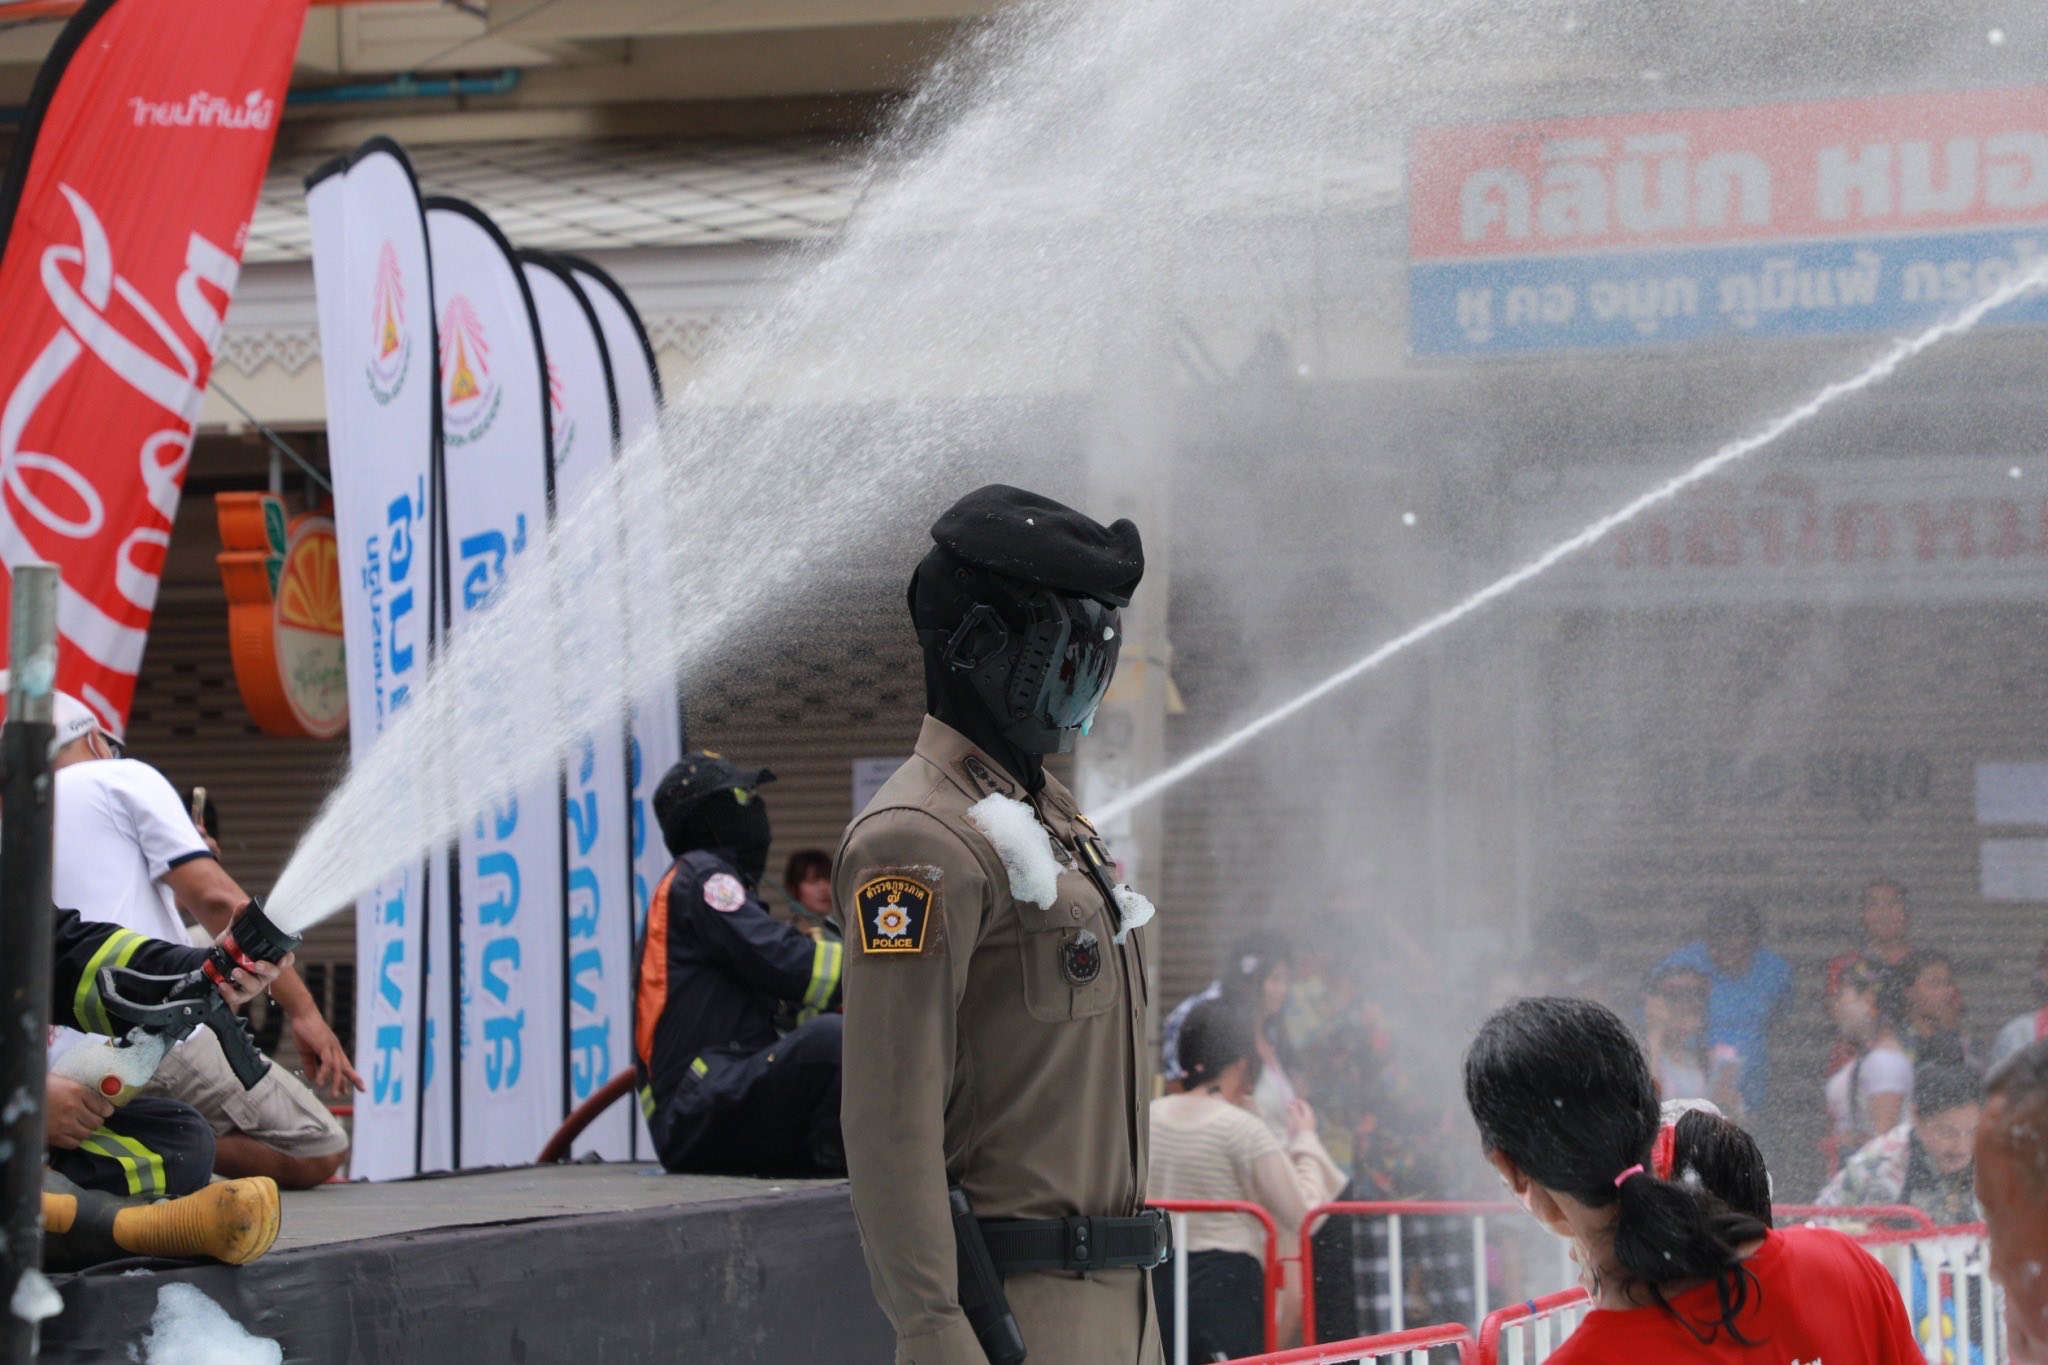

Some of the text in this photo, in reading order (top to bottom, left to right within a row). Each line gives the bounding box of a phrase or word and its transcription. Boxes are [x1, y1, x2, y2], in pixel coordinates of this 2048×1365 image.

[1458, 131, 1773, 243] คลินิก
[1456, 287, 1493, 342] หู
[1504, 284, 1575, 326] คอ
[1589, 276, 1699, 334] จมูก
[873, 938, 913, 949] POLICE
